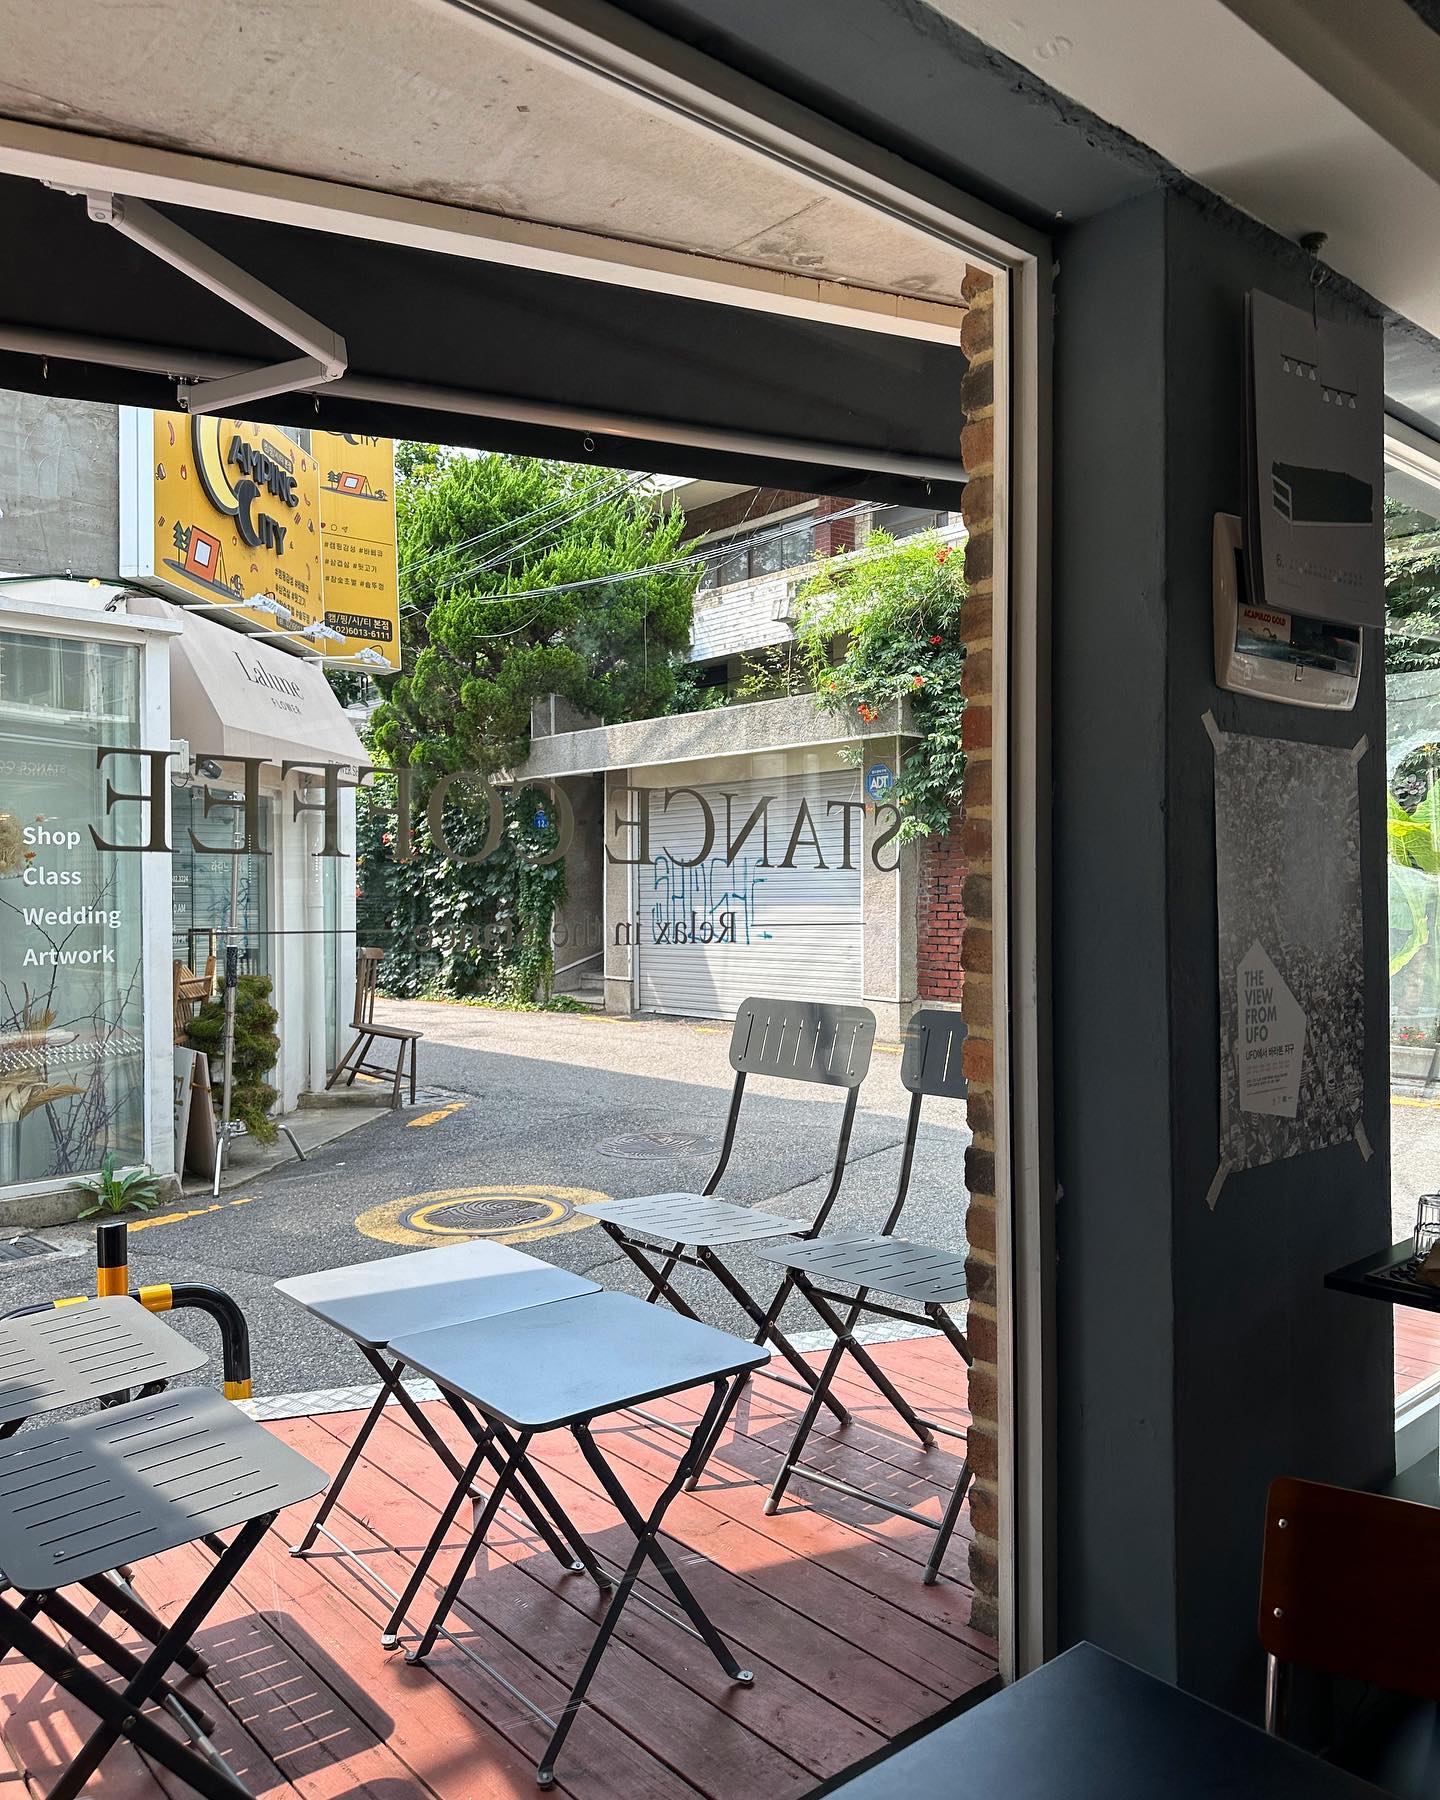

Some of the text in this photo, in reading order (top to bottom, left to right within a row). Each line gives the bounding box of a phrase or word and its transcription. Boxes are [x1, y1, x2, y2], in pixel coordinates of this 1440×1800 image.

[234, 479, 287, 556] CITY
[373, 619, 390, 631] 본점
[1272, 614, 1287, 626] GOLD
[232, 650, 305, 700] Lalune
[271, 697, 302, 715] FLOWER
[870, 775, 889, 790] ADT
[23, 826, 81, 850] Shop
[23, 866, 82, 887] Class
[23, 905, 122, 930] Wedding
[23, 945, 116, 968] Artwork
[1244, 970, 1264, 987] THE
[1245, 988, 1274, 1006] VIEW
[1245, 1007, 1277, 1026] FROM
[1246, 1027, 1269, 1044] UFO
